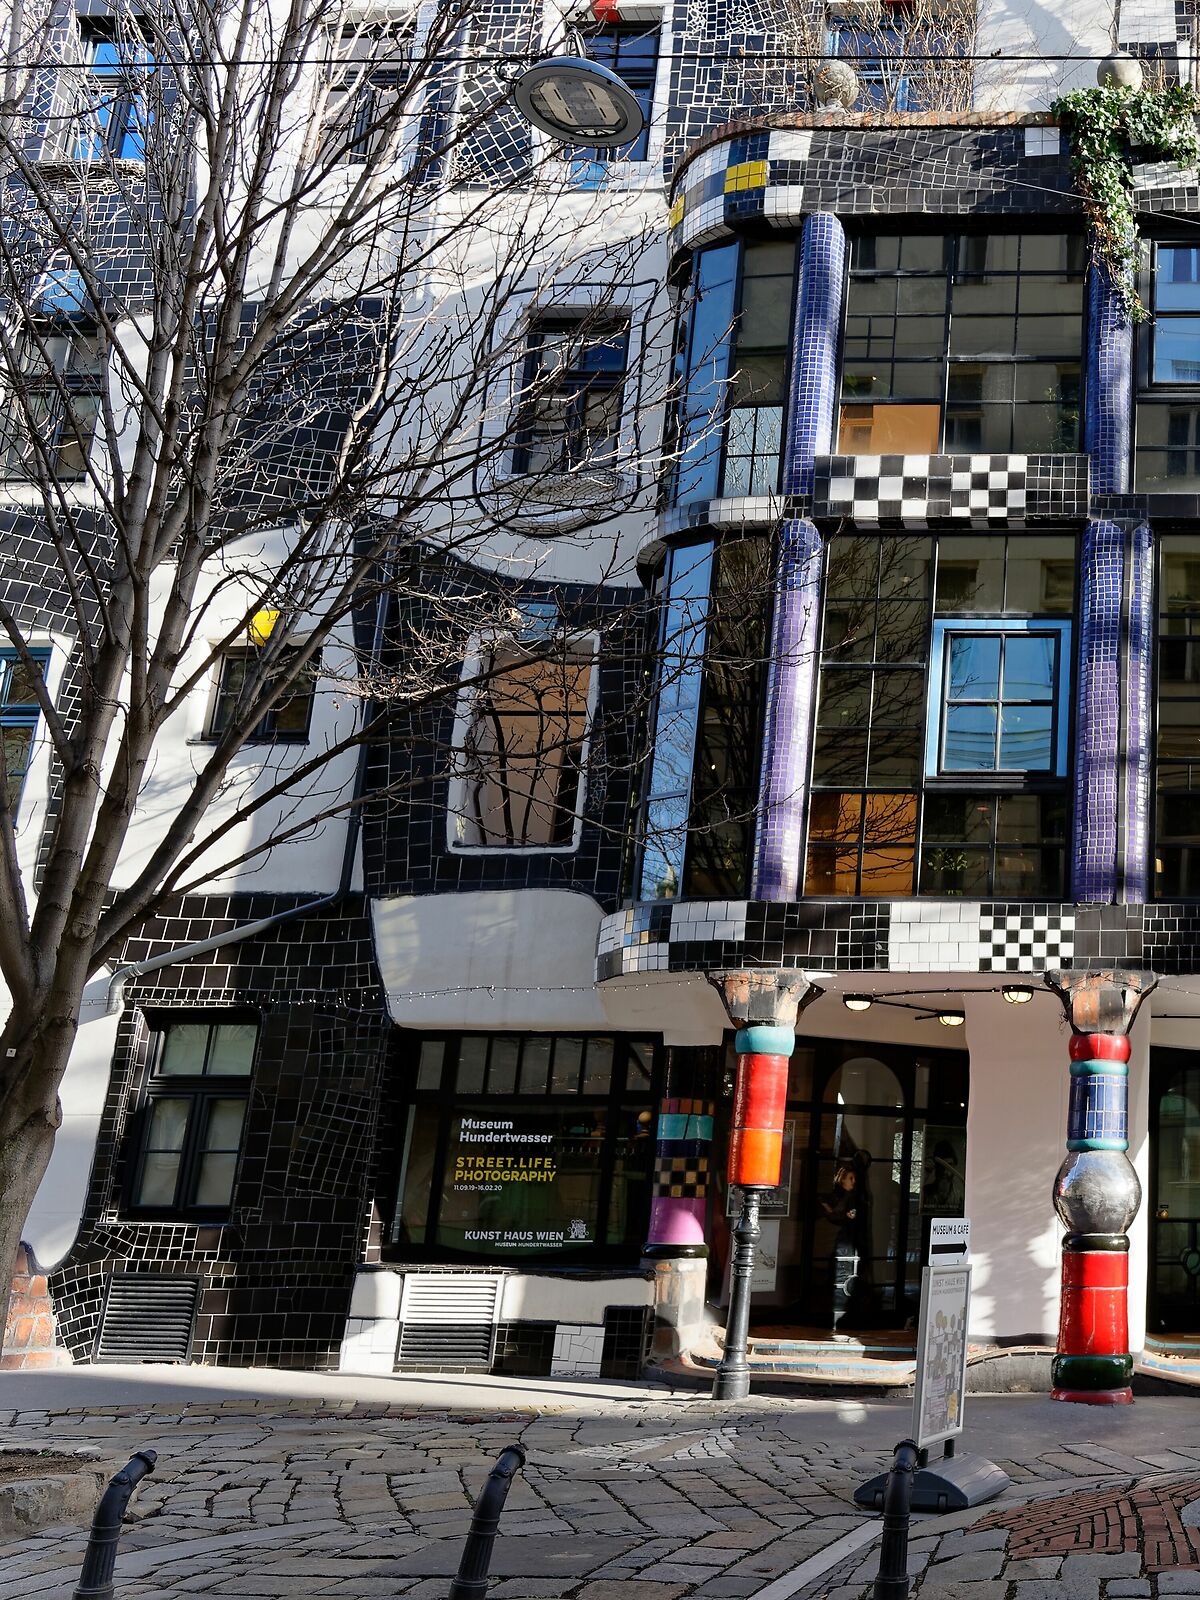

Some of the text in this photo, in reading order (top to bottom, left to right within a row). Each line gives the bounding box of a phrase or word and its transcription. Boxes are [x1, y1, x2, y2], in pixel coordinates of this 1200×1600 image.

[461, 1118, 513, 1129] Museum
[459, 1132, 553, 1143] Hundertwasser
[456, 1157, 557, 1168] STREET.LIFE.
[454, 1170, 556, 1182] PHOTOGRAPHY
[464, 1230, 564, 1241] KUNST HAUS WIEN
[932, 1225, 953, 1234] MUSEUM
[953, 1225, 957, 1235] &
